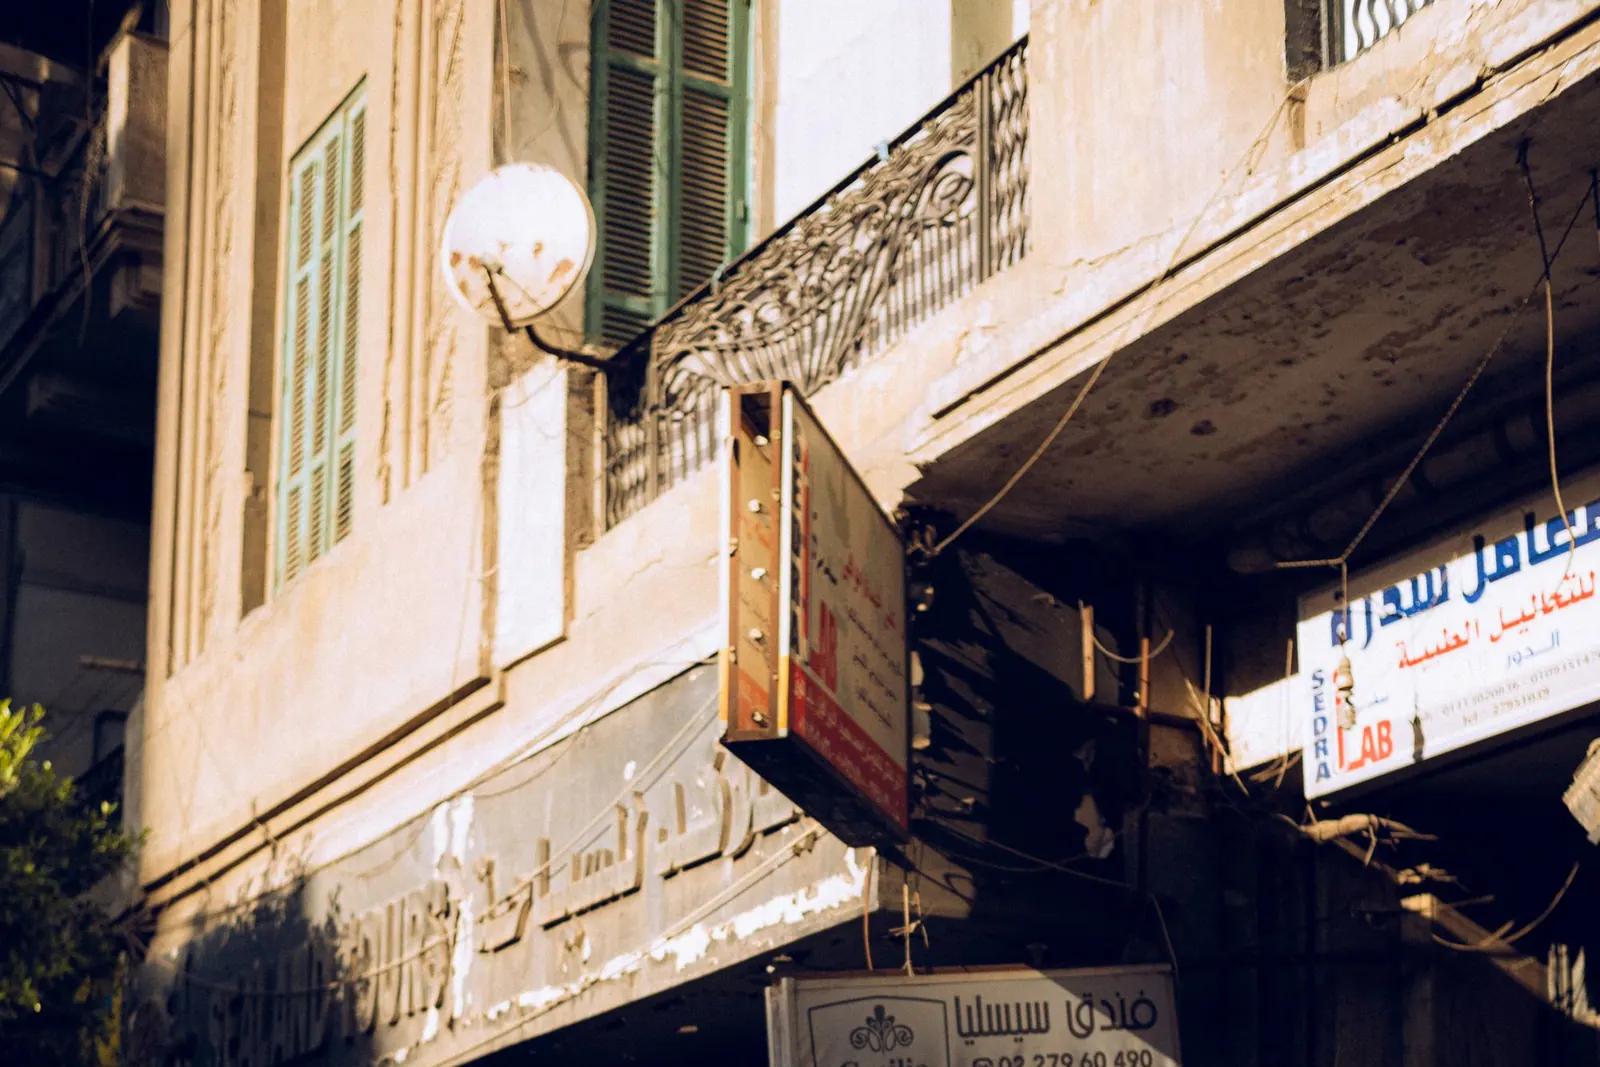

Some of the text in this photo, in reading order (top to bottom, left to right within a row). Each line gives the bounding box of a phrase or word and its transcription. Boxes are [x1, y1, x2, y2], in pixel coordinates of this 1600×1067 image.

[1311, 668, 1331, 783] SEDRA
[1336, 718, 1394, 773] LAB
[1065, 990, 1158, 1039] فندق
